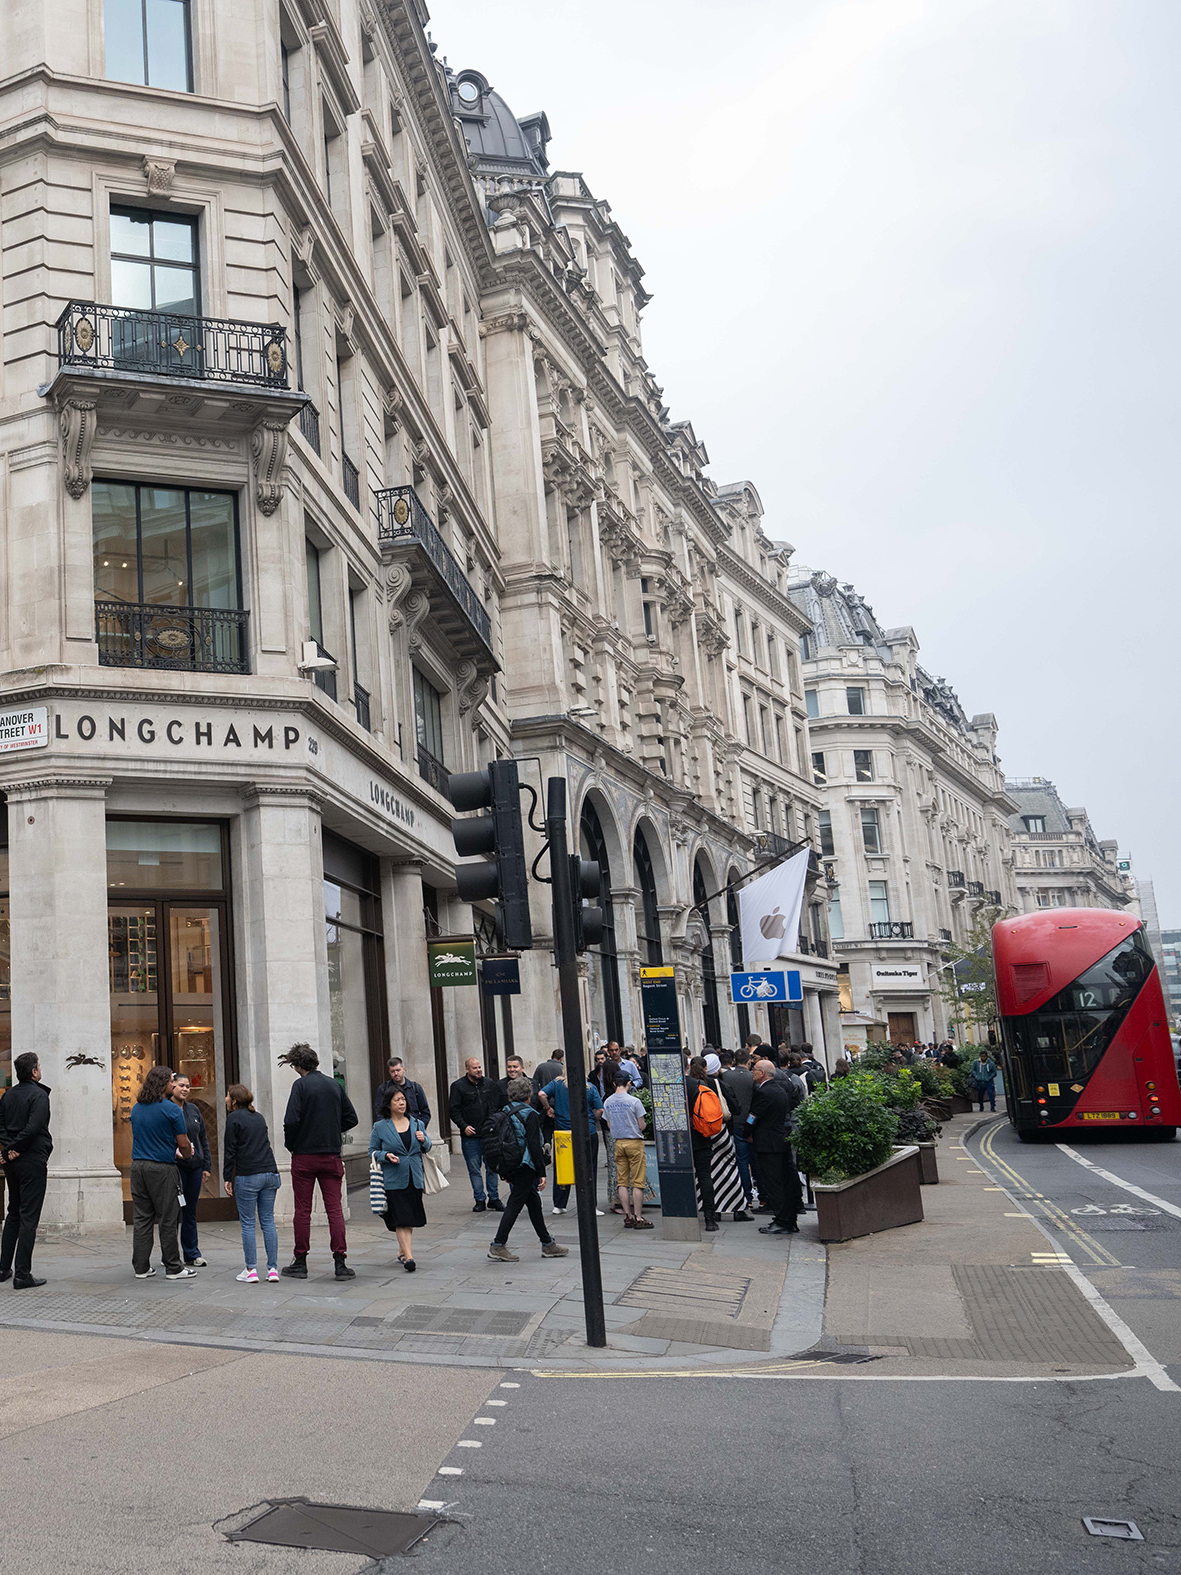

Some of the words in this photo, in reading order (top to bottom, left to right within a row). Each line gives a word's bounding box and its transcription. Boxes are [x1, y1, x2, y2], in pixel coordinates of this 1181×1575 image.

[28, 723, 42, 735] W1
[55, 714, 300, 750] LONGCHAMP
[10, 740, 38, 748] WESTMINSTER
[370, 780, 415, 828] LONGCHAMP
[1079, 991, 1097, 1008] 12
